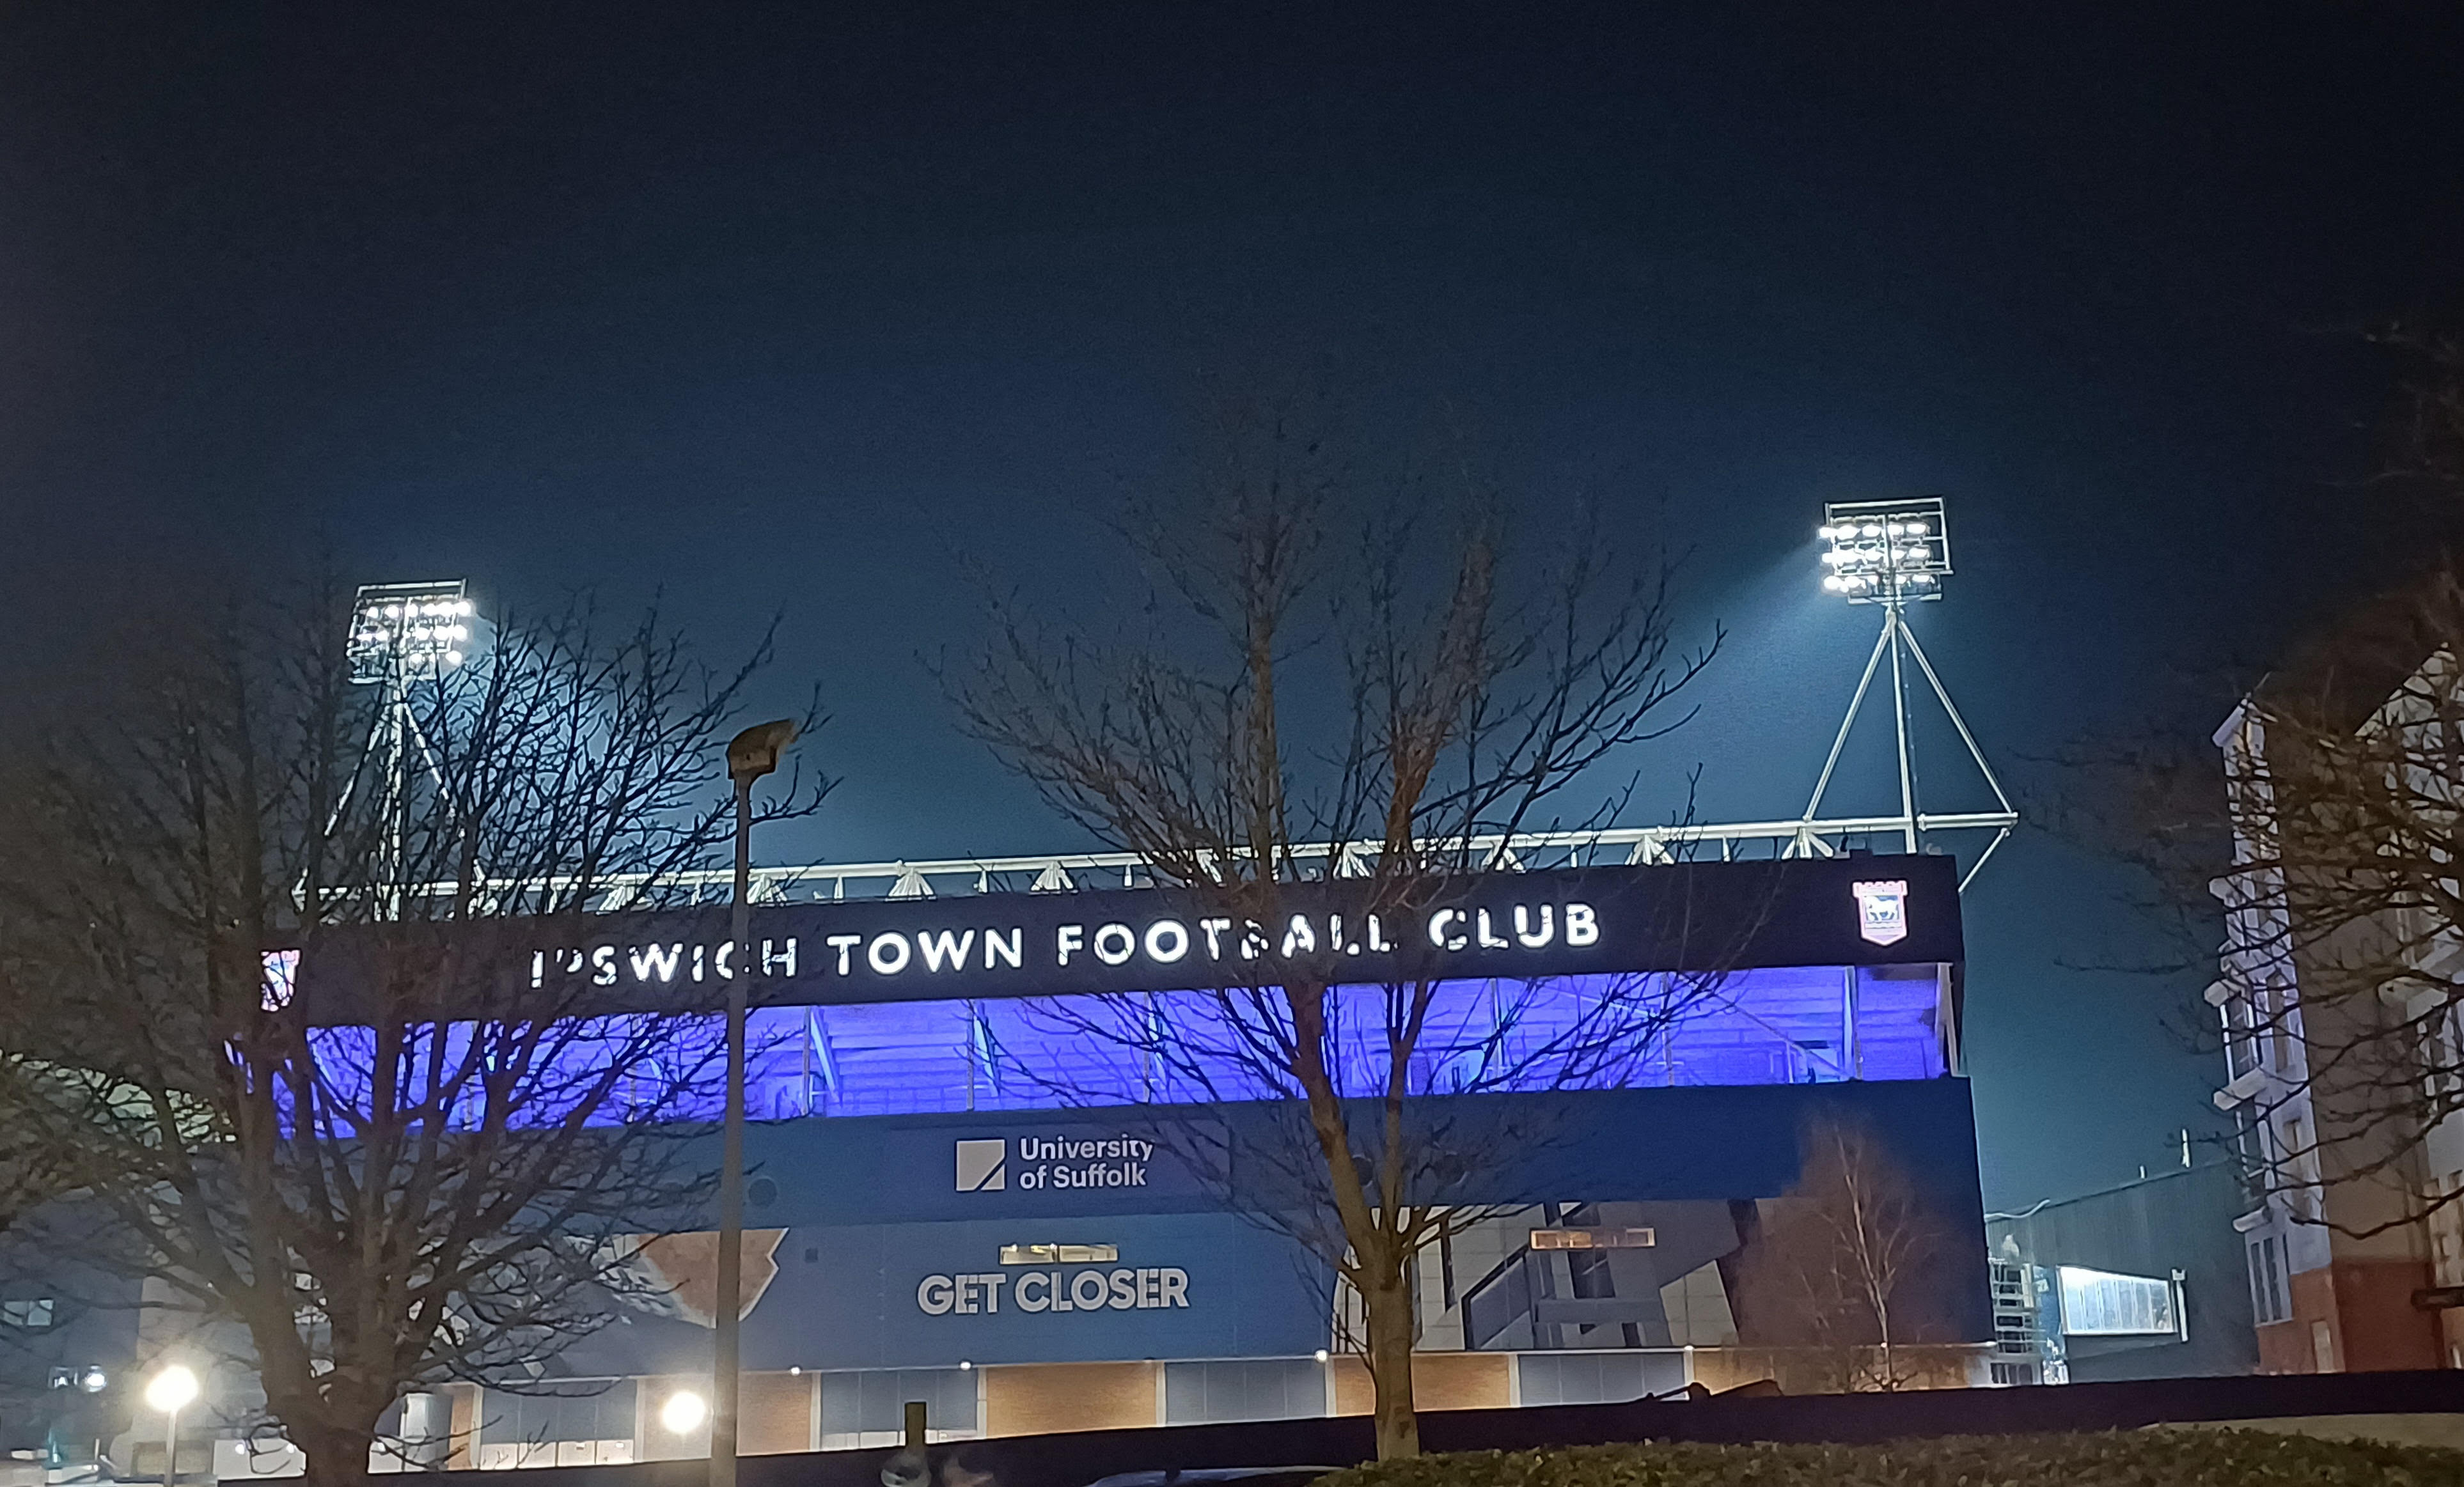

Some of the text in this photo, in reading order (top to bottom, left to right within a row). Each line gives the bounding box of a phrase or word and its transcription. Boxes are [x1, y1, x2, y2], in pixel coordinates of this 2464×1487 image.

[826, 927, 1023, 976] TOWN
[1428, 903, 1599, 951] CLUB
[1021, 1135, 1153, 1162] University
[1019, 1162, 1147, 1189] of Suffolk
[917, 1268, 1190, 1315] GET CLOSER
